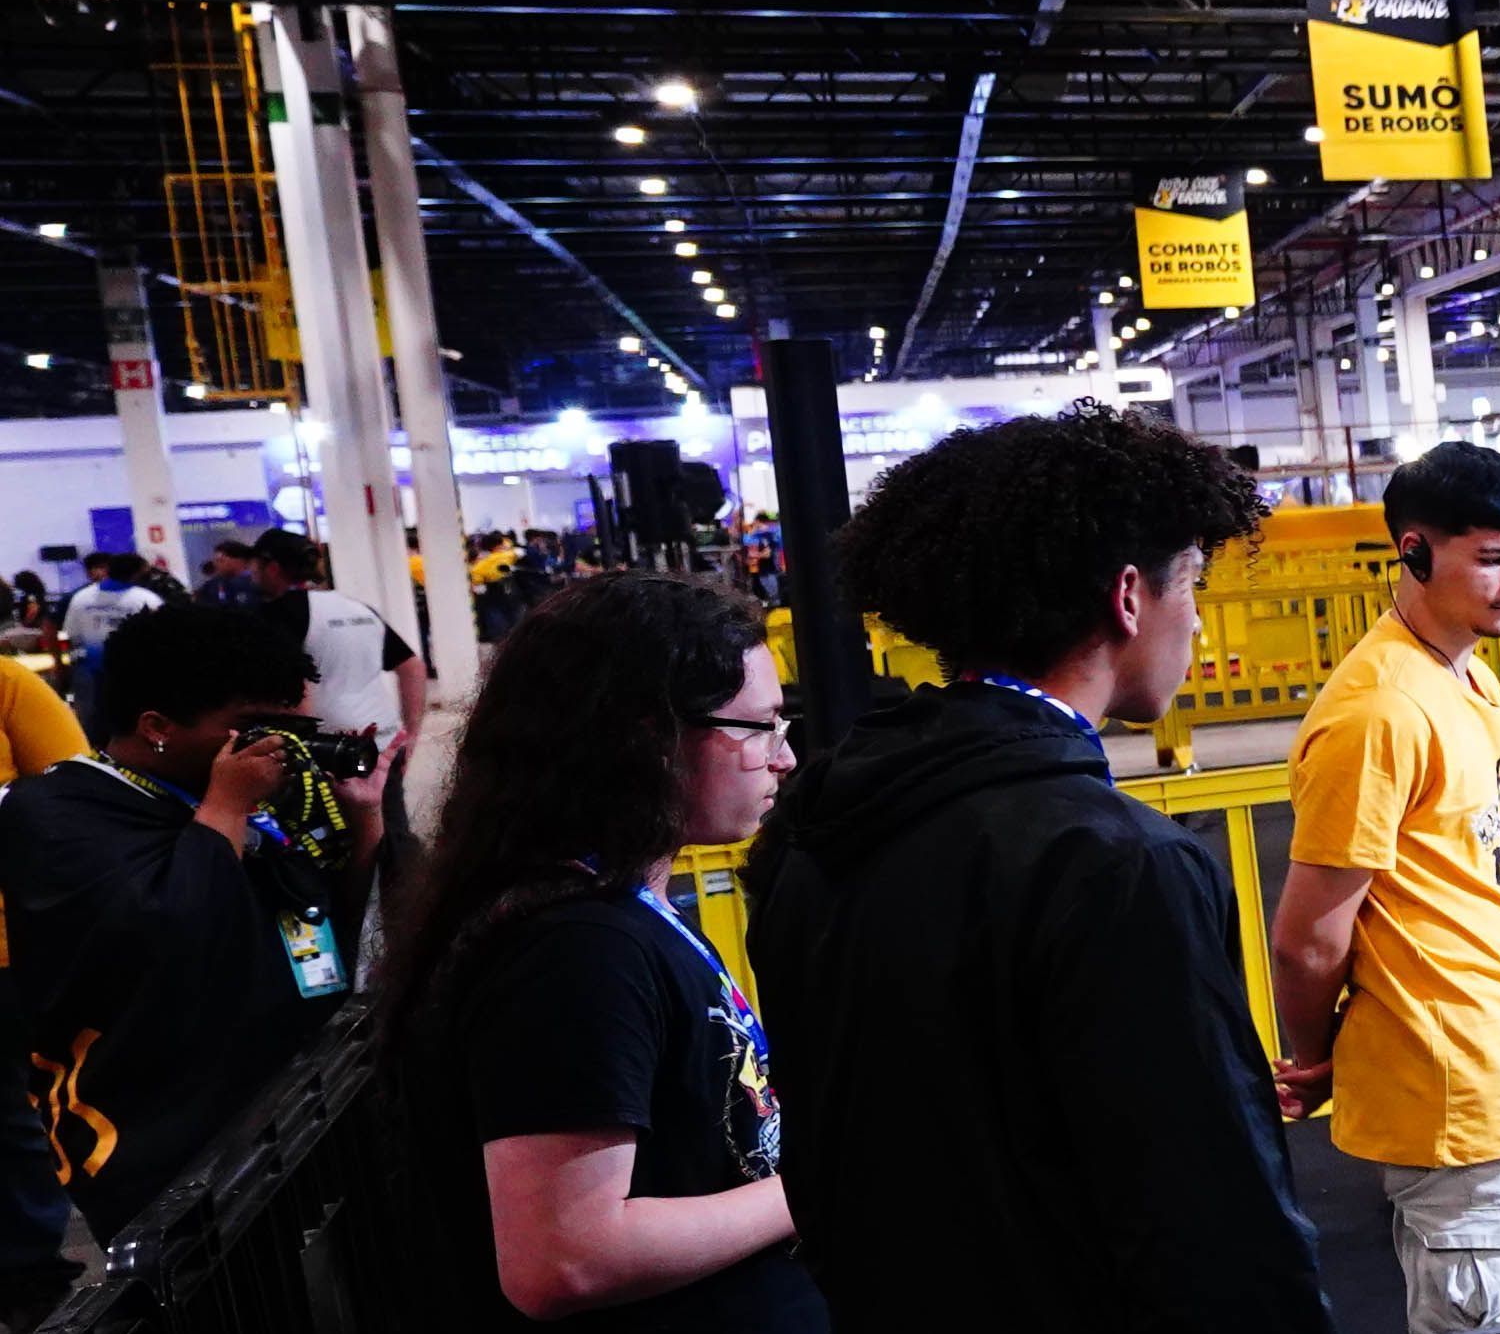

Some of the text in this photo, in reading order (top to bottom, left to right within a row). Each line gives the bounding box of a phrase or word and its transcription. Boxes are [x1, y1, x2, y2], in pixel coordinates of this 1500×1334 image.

[1343, 77, 1461, 110] SUMÔ
[1345, 113, 1464, 132] DE ROBÔS
[1148, 243, 1240, 257] COMBATE
[1150, 260, 1173, 274] DE
